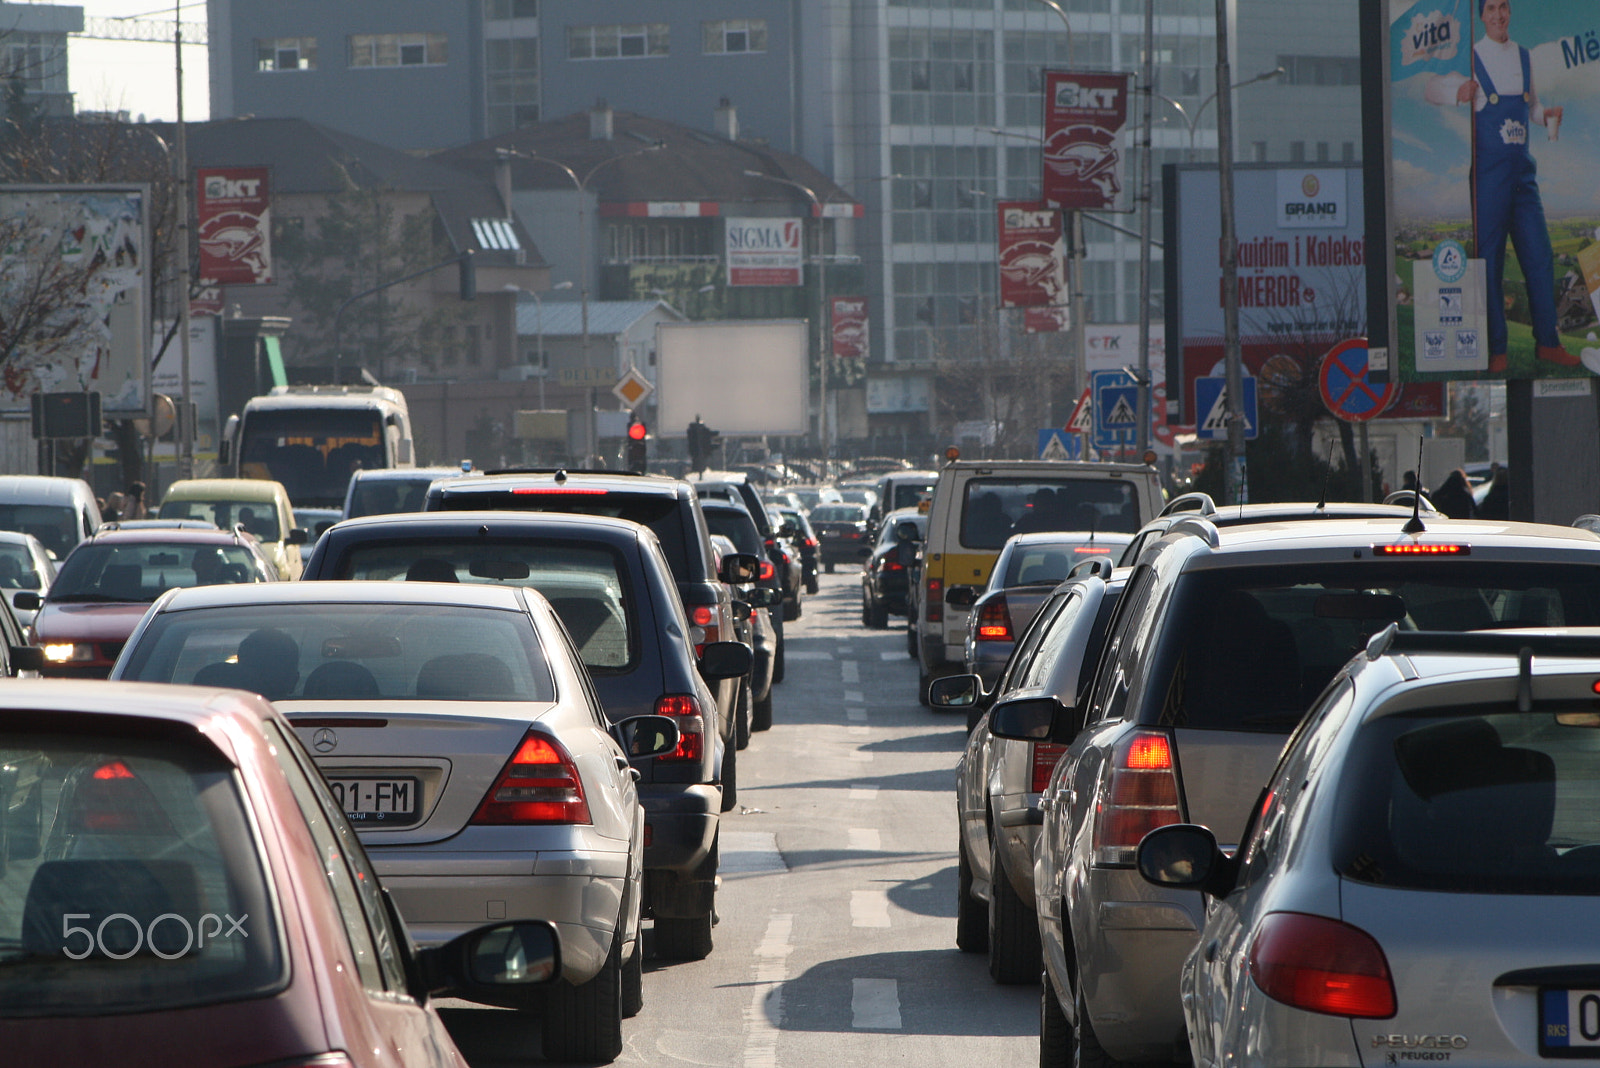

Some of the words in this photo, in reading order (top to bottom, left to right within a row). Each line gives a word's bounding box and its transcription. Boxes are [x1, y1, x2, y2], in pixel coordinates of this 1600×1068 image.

[1413, 21, 1451, 50] vita
[1055, 82, 1119, 109] BKT
[204, 176, 260, 199] BKT
[1004, 208, 1055, 229] BKT
[1285, 202, 1337, 215] GRAND
[728, 226, 783, 249] SIGMA
[1547, 1024, 1568, 1037] RKS
[1401, 1051, 1452, 1061] PEUGEOT
